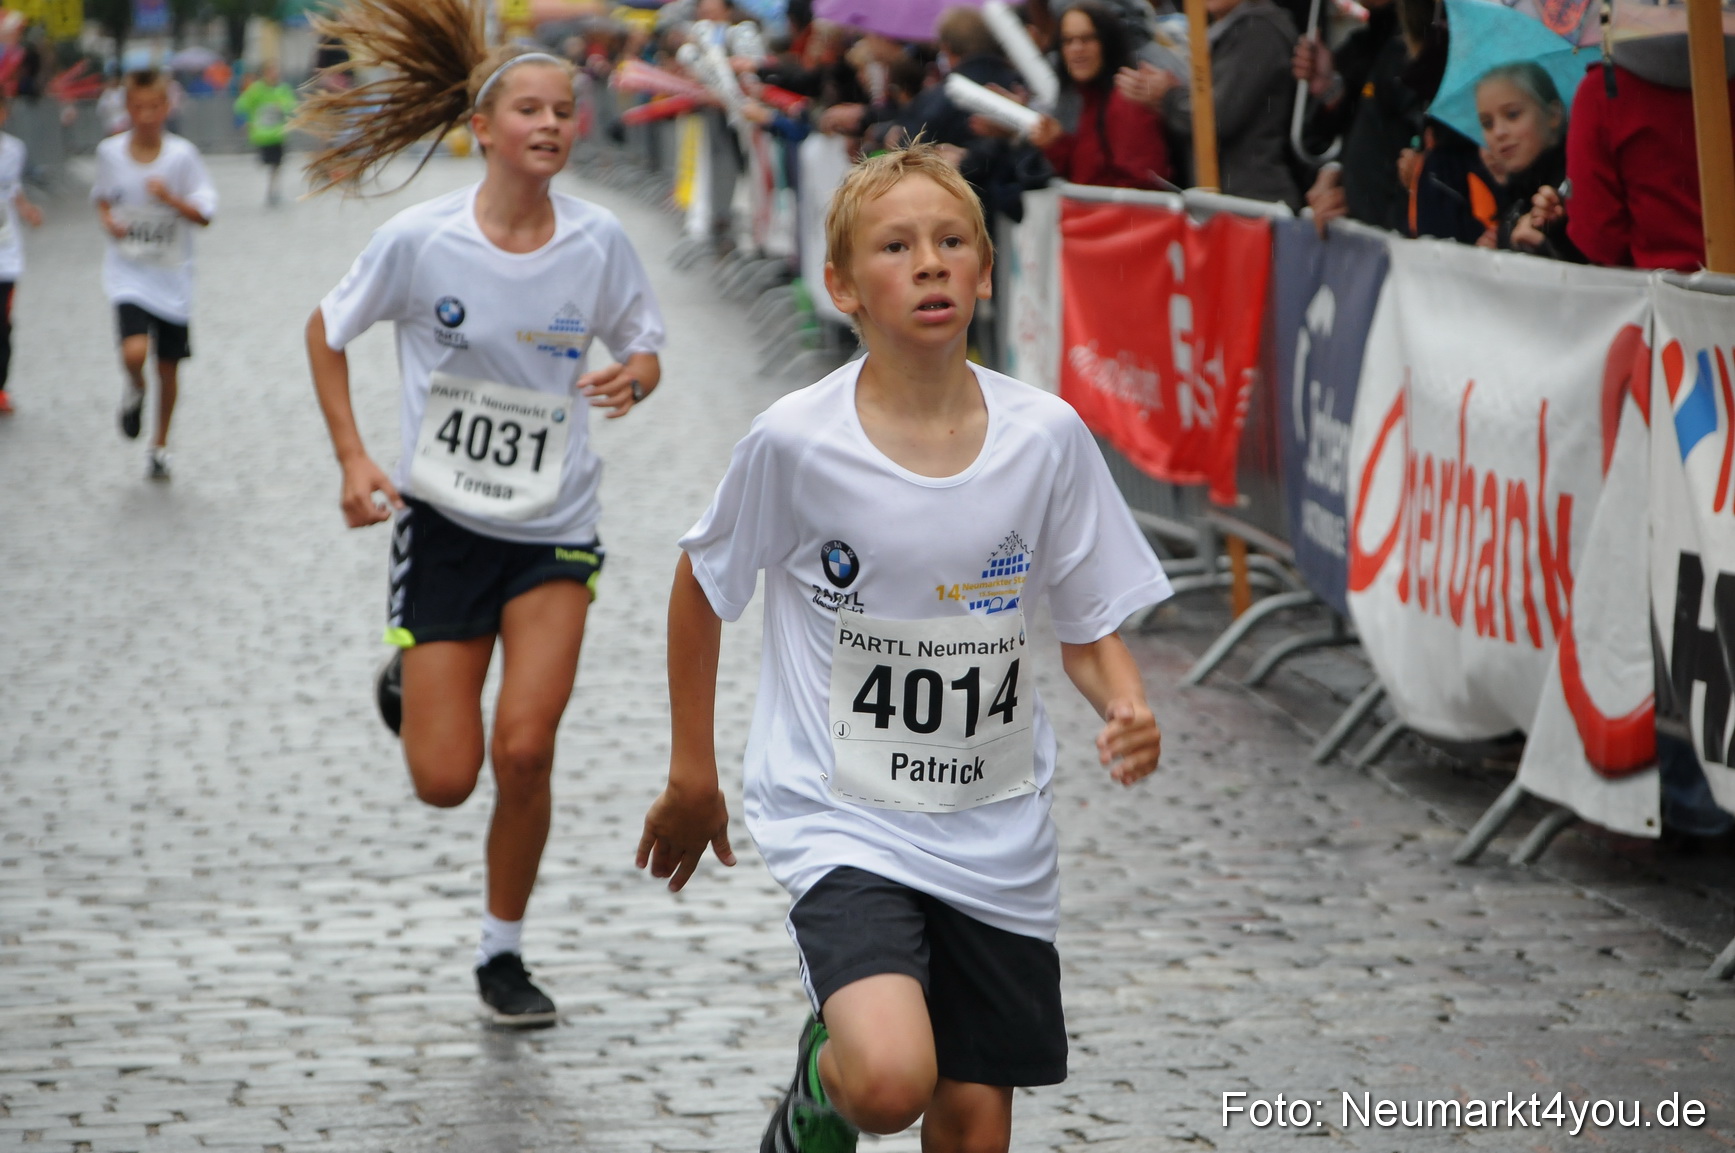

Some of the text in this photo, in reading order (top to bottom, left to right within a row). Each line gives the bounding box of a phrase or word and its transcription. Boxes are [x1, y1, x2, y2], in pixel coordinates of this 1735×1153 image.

[431, 383, 547, 418] PARTL Neumarkt
[436, 407, 549, 474] 4031
[453, 471, 515, 501] Teresa
[935, 584, 967, 601] 14.
[962, 579, 1012, 591] Neumarkter
[839, 629, 1015, 658] PARTL Neumarkt
[852, 658, 1020, 738] 4014
[890, 752, 986, 785] Patrick
